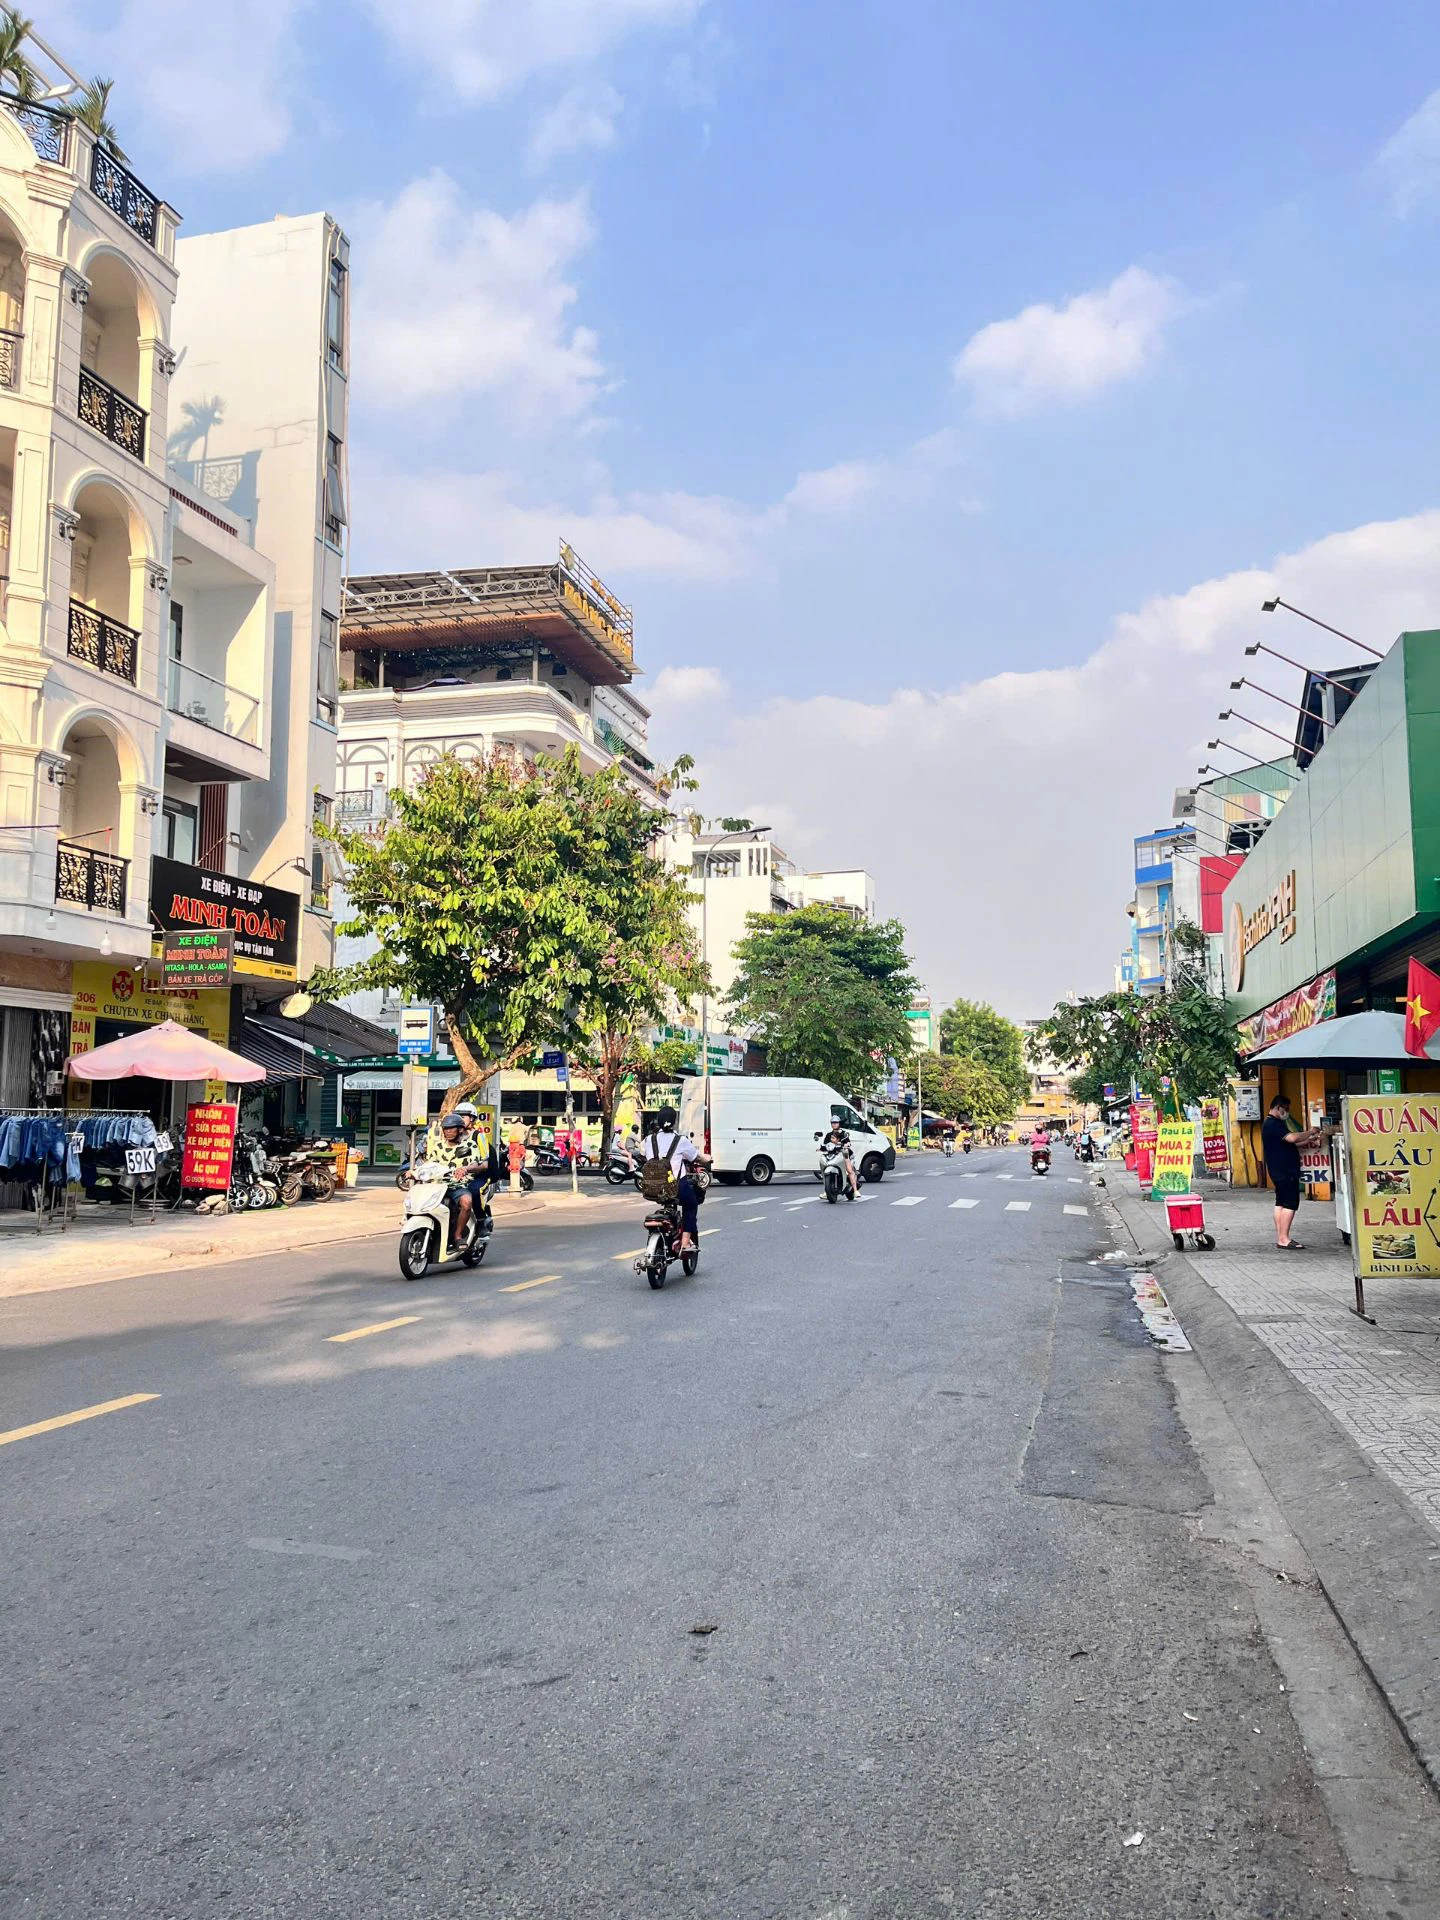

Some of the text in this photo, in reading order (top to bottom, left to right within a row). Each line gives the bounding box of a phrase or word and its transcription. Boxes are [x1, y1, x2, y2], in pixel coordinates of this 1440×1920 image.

[201, 877, 211, 891] XE
[212, 880, 231, 897] ĐIỆN
[237, 886, 247, 900] XE
[247, 890, 263, 905] ĐẠP
[170, 894, 286, 941] MINH TOÀN
[178, 934, 218, 947] XE ĐIỆN
[166, 945, 228, 961] MINH TOÀN
[167, 973, 224, 984] BÁN XE TRẢ GÓP
[76, 992, 96, 1003] 306
[142, 1009, 152, 1020] XE
[72, 1018, 91, 1034] BÁN
[72, 1039, 88, 1055] TRẢ
[1353, 1101, 1439, 1135] QUÁN
[1162, 1127, 1179, 1135] Rau
[187, 1137, 197, 1145] XE
[1160, 1141, 1192, 1150] MUA 2
[1156, 1152, 1192, 1165] TÍNH 1
[1367, 1138, 1433, 1166] LẨU
[127, 1150, 154, 1172] 59K
[1300, 1170, 1329, 1182] 5K
[1363, 1197, 1422, 1226] LẨU
[1370, 1262, 1431, 1273] BÌNH DÂN
